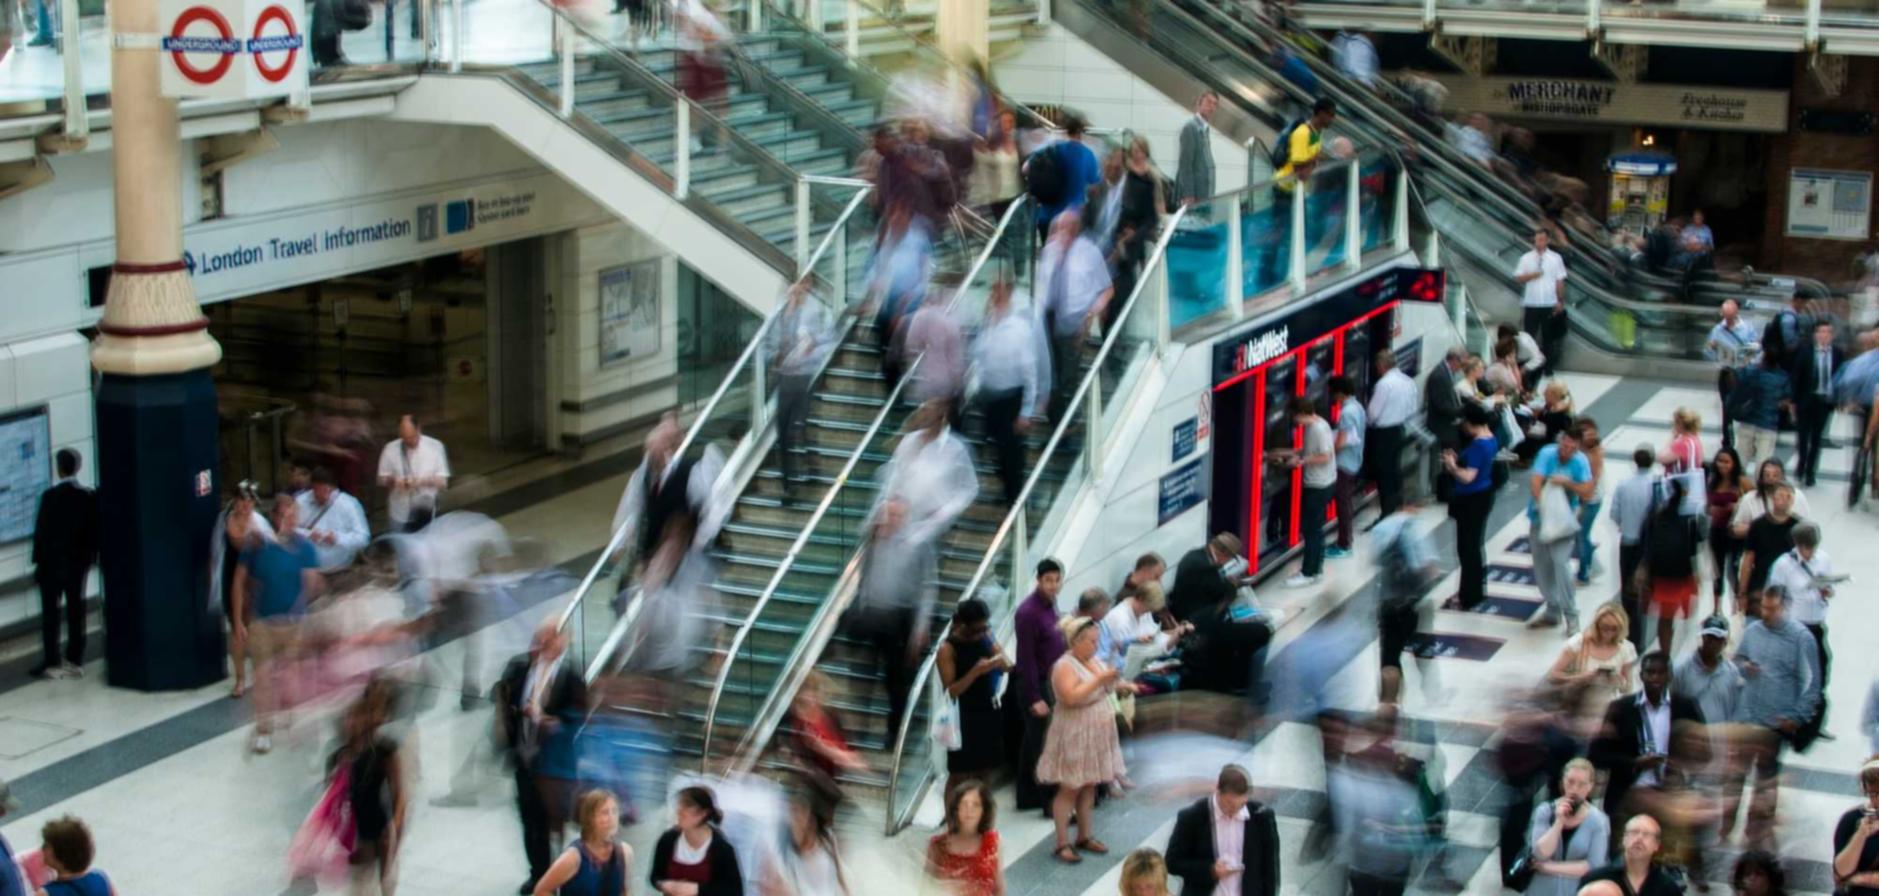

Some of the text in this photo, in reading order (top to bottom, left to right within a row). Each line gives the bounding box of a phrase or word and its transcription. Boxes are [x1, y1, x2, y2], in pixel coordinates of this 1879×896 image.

[166, 38, 238, 51] UNDERGROUND
[249, 36, 301, 51] UNDERGROUND
[1508, 81, 1616, 104] MERCHANT
[202, 244, 263, 275] London
[270, 232, 318, 260] Travel
[1248, 324, 1289, 369] NatWest
